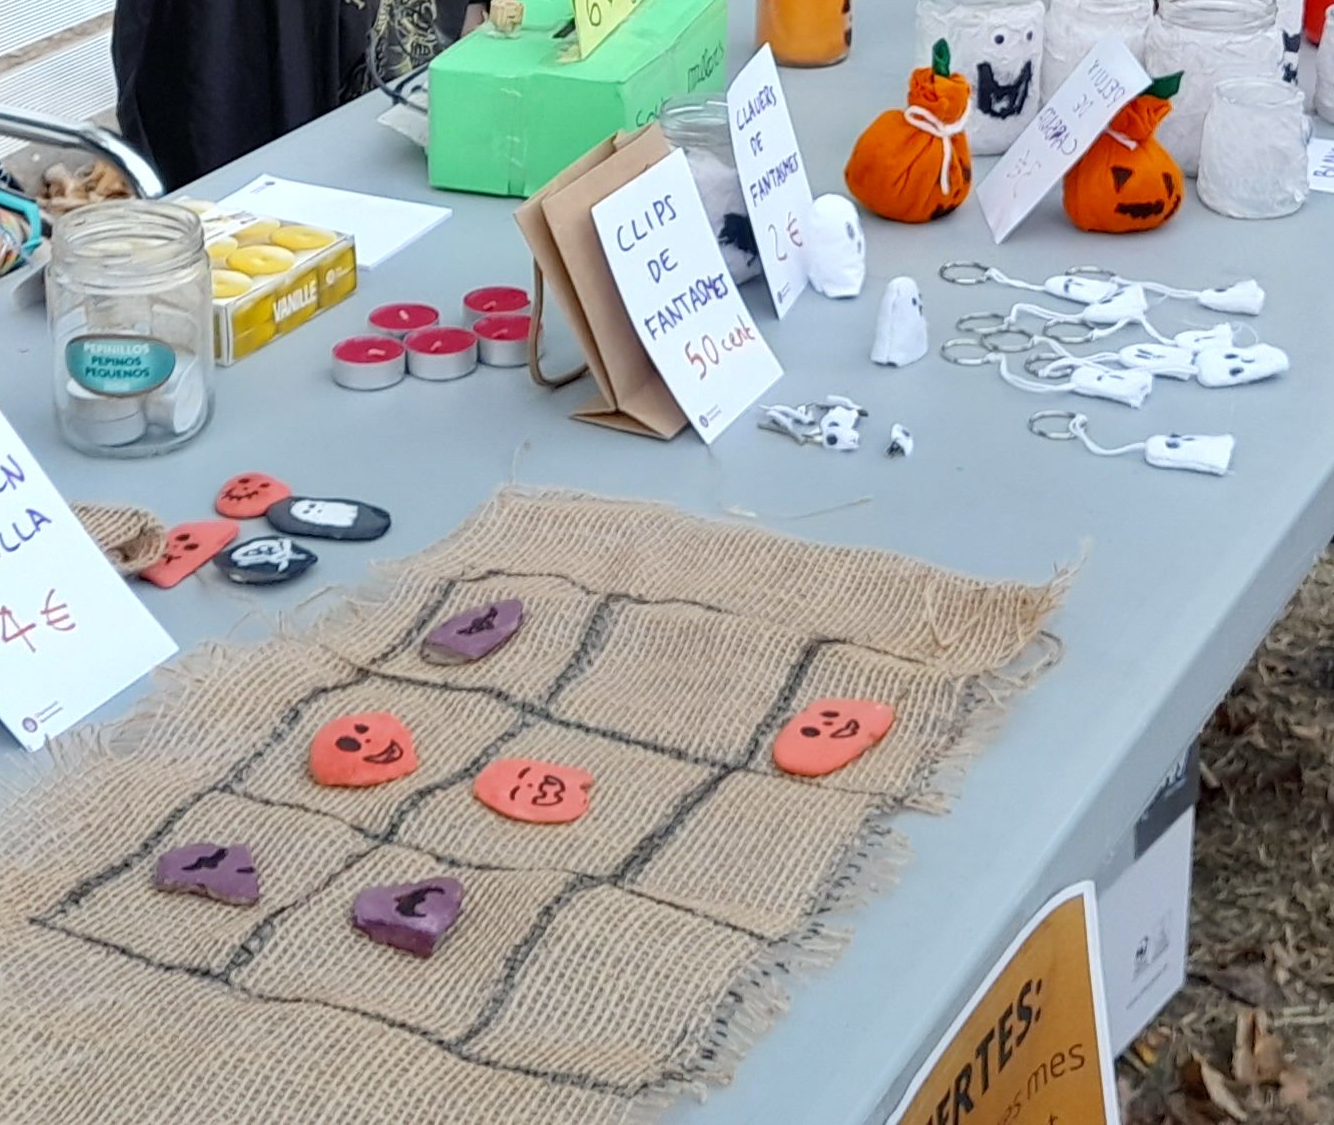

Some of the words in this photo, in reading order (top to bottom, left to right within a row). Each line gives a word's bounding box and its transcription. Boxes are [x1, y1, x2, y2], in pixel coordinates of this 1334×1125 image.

[750, 131, 764, 157] DE
[750, 152, 799, 208] FANTASMES
[617, 194, 677, 252] CLIPS
[647, 248, 678, 283] DE
[273, 280, 317, 324] VANILLE
[644, 273, 729, 340] FANTASMES
[91, 356, 142, 366] PEPINOS
